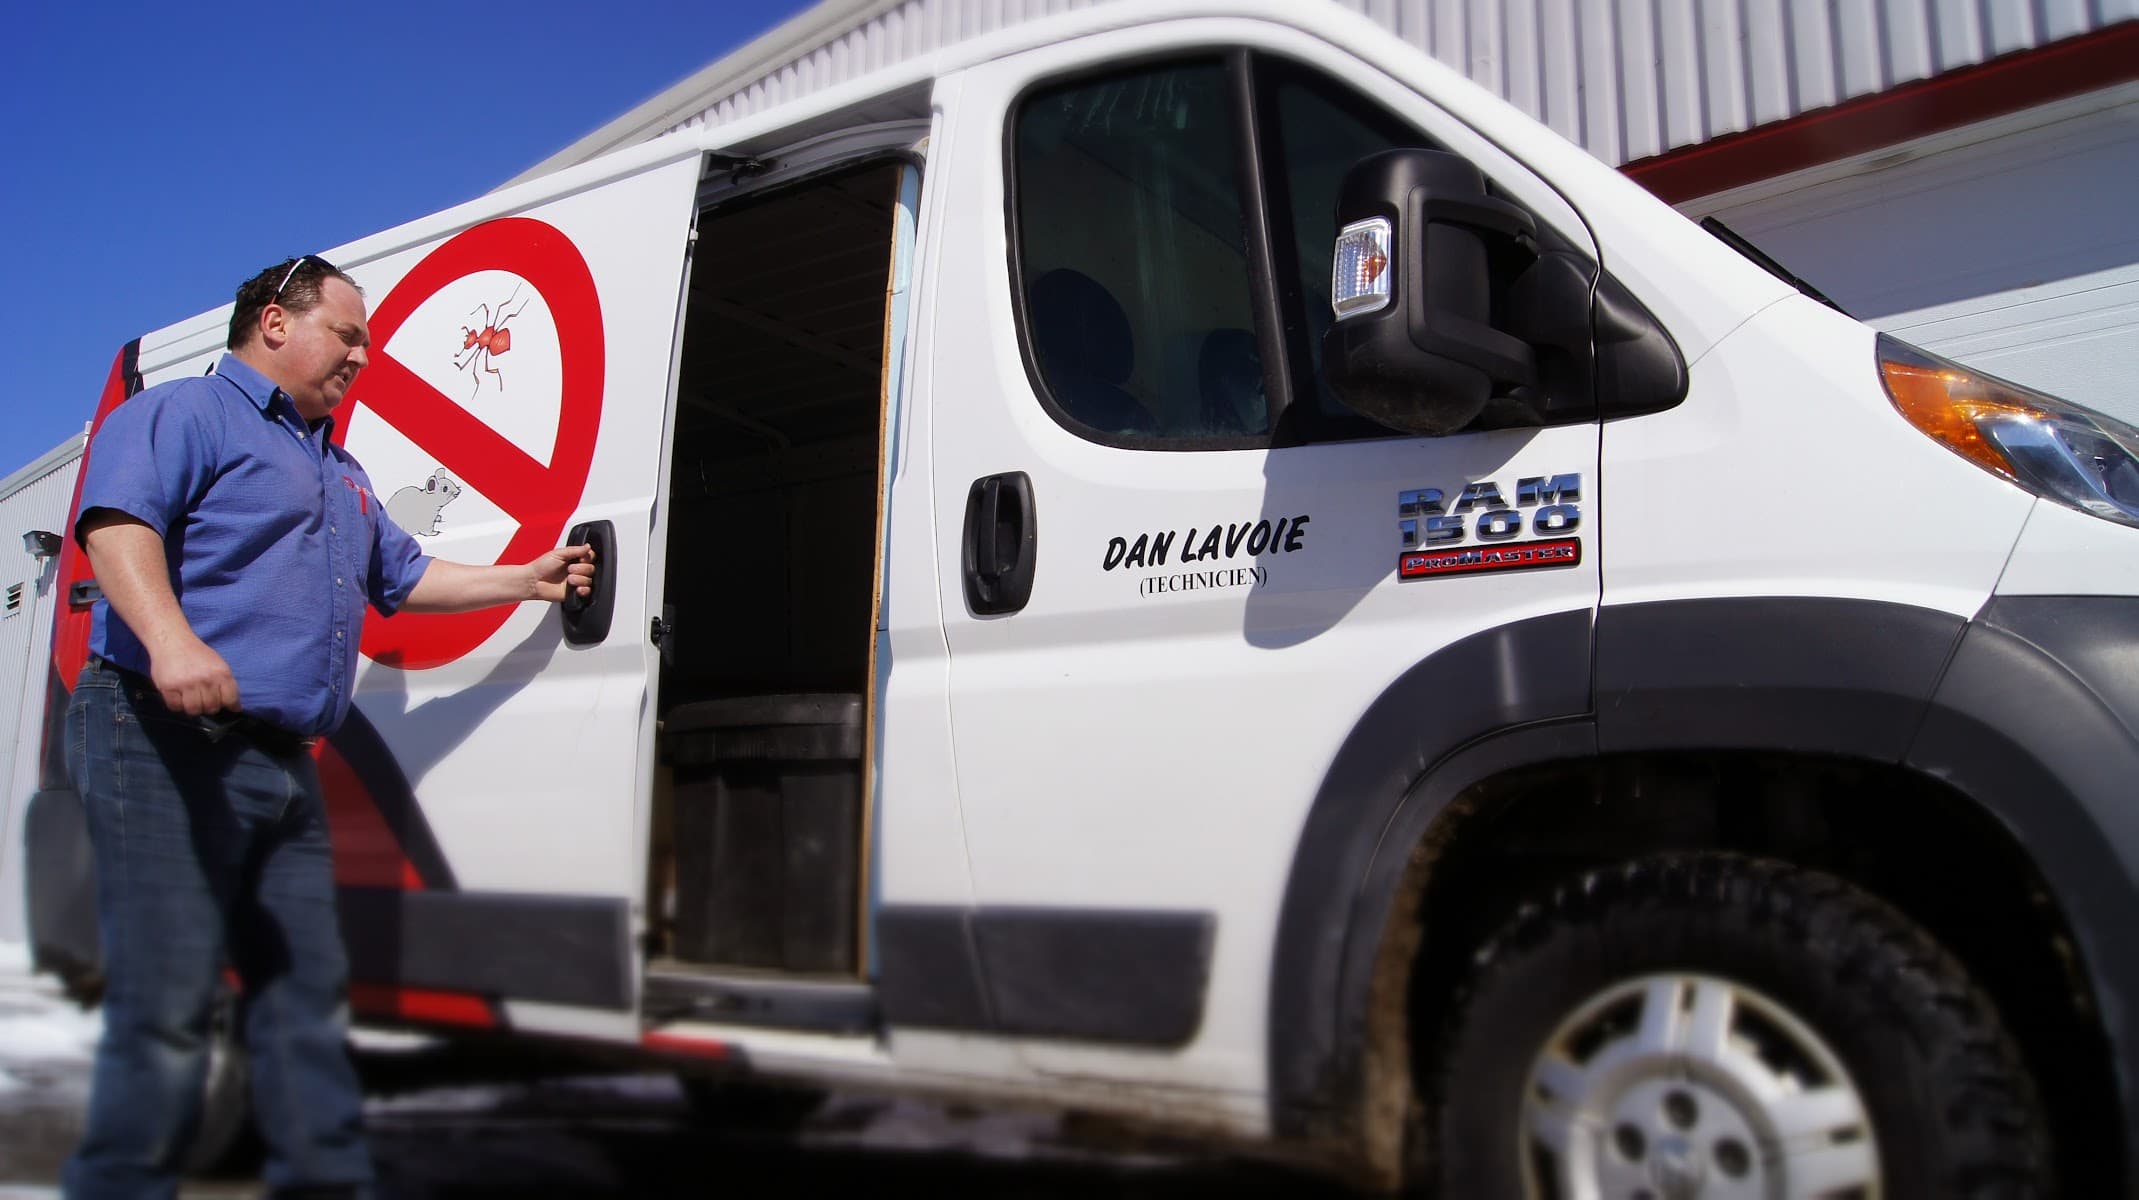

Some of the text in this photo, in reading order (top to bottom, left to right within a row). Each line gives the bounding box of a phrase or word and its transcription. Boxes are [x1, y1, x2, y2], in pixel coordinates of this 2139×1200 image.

[1398, 472, 1582, 518] RAM
[1102, 515, 1311, 572] DAN LAVOIE
[1399, 504, 1582, 548] 1500
[1139, 566, 1268, 598] (TECHNICIEN)
